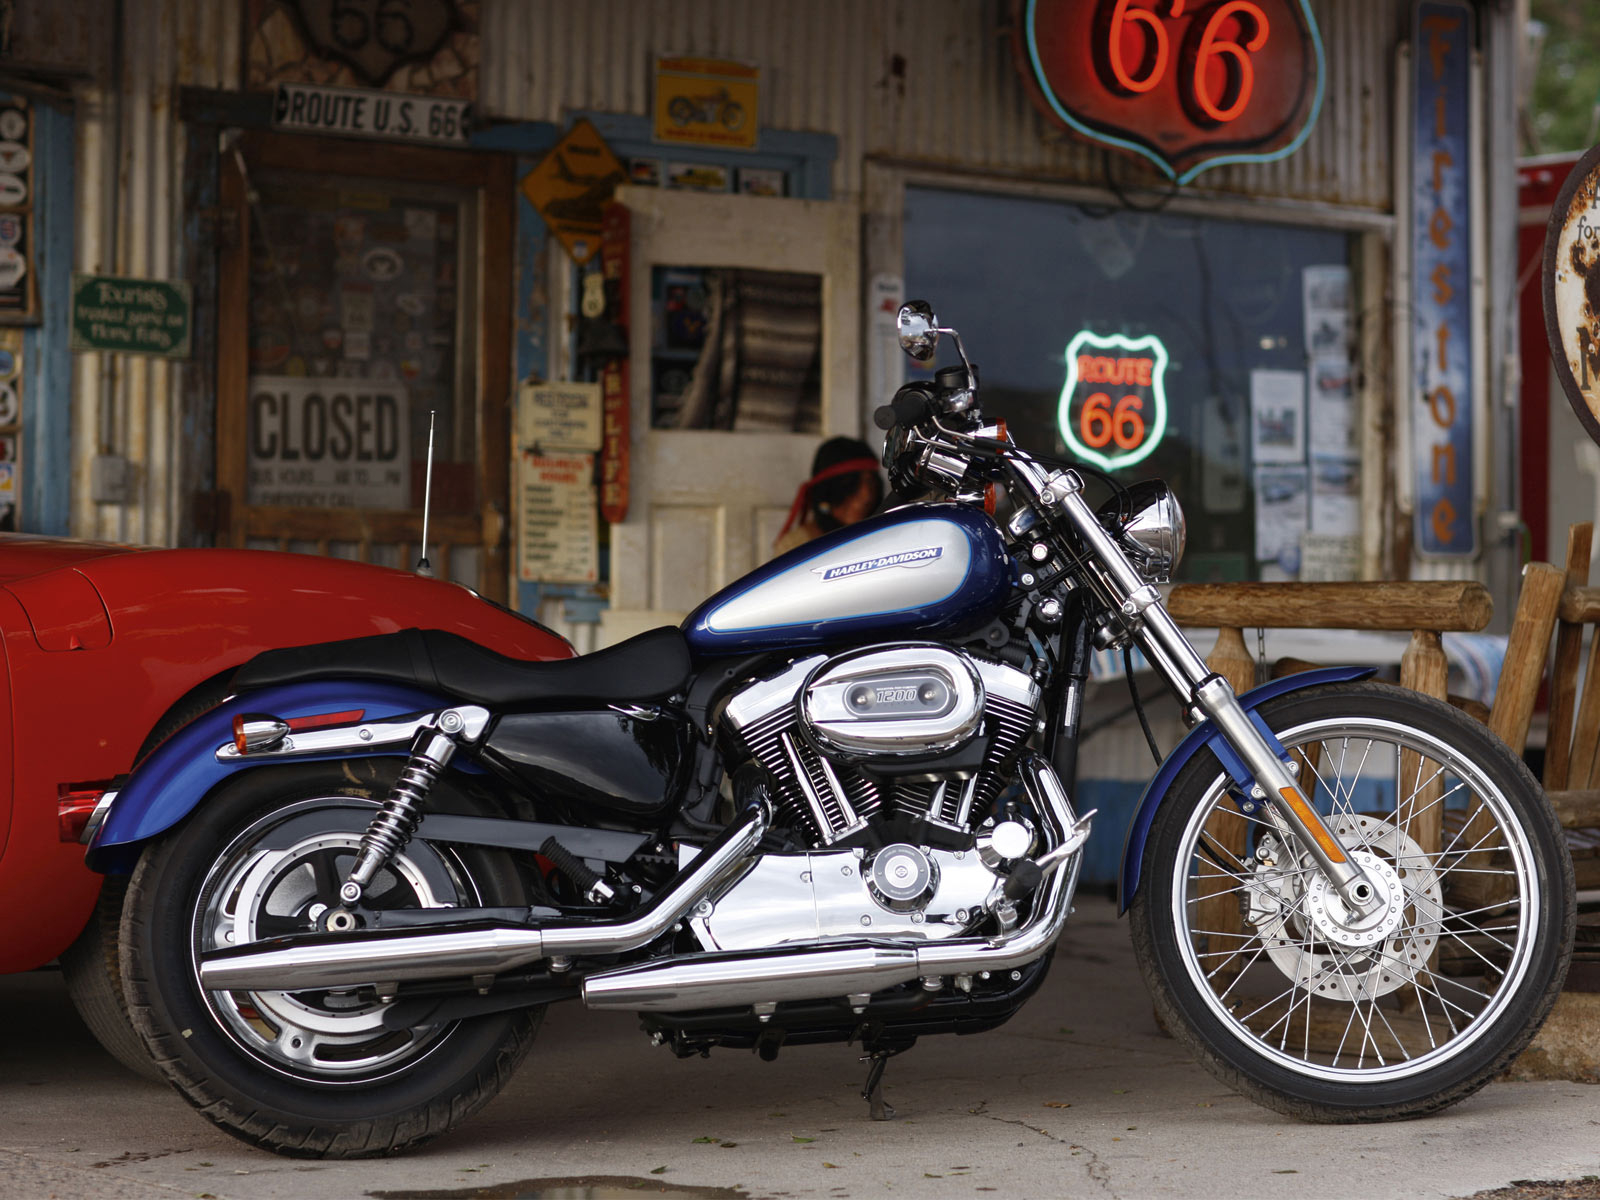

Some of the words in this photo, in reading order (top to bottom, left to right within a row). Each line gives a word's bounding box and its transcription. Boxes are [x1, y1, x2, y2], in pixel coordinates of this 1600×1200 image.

[1108, 0, 1270, 122] 66
[290, 90, 367, 129] ROUTE
[373, 98, 419, 134] U.S.
[428, 103, 458, 138] 66
[1421, 14, 1461, 544] Firestone
[1077, 354, 1153, 386] ROUTE
[252, 391, 400, 462] CLOSED
[1081, 392, 1144, 450] 66
[829, 548, 938, 578] HARLEY-DAVIDSON
[876, 688, 917, 704] 1200
